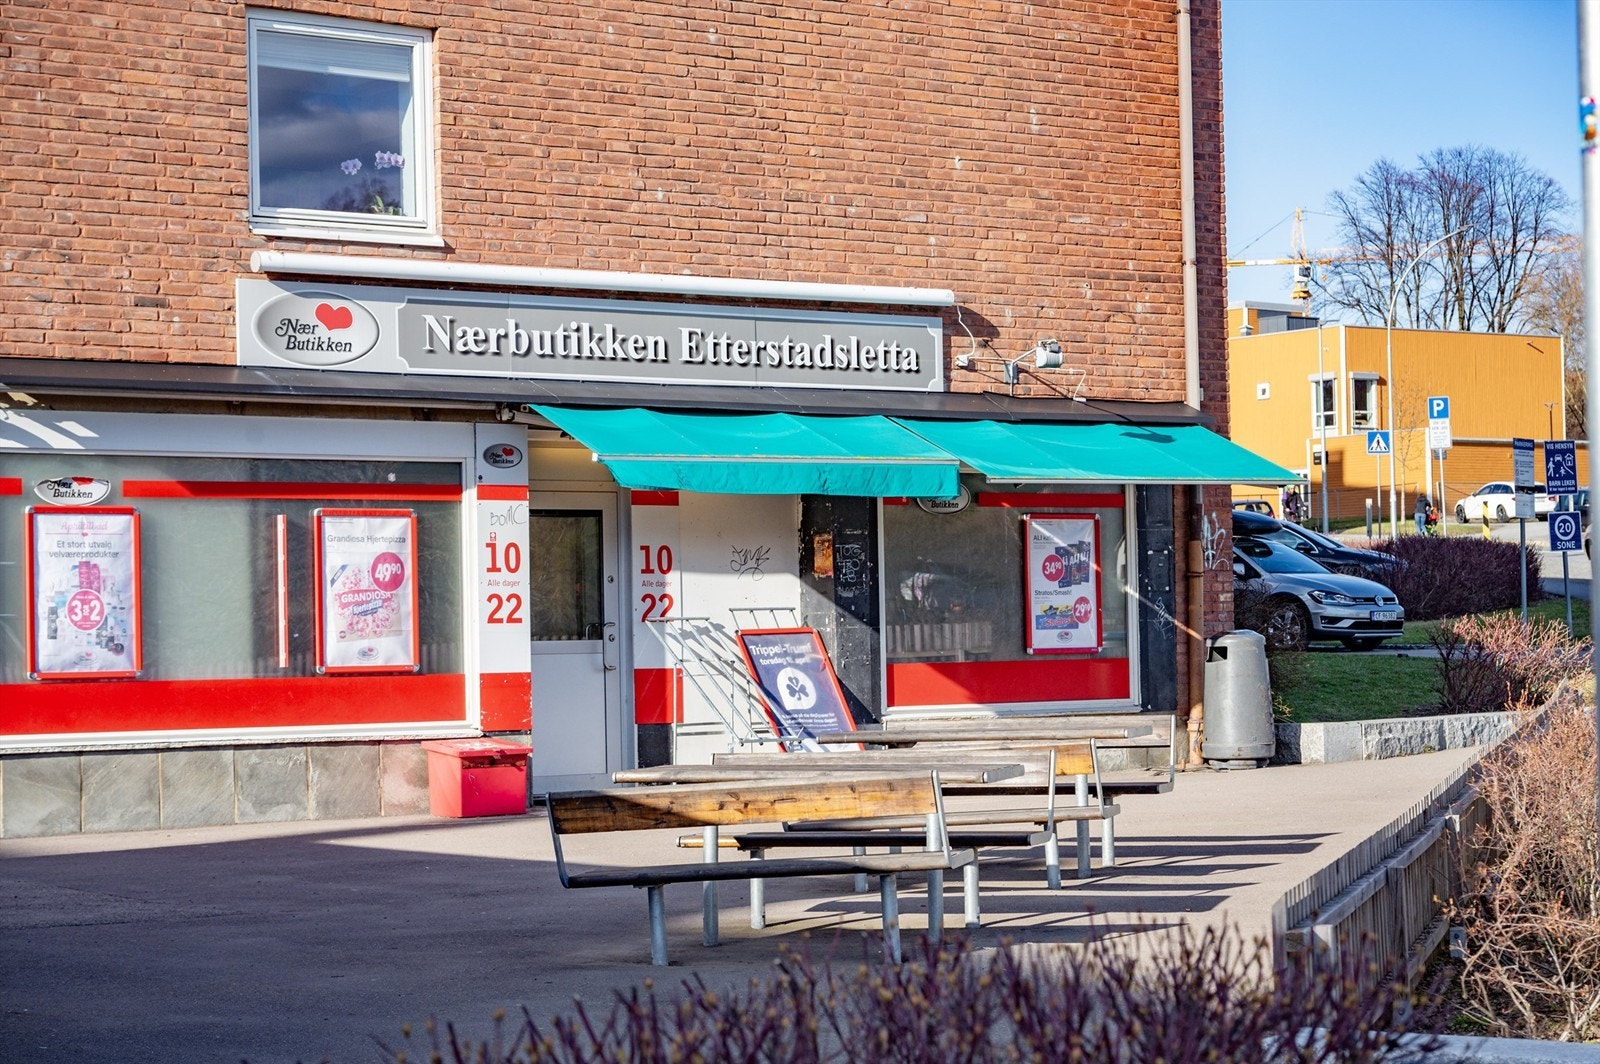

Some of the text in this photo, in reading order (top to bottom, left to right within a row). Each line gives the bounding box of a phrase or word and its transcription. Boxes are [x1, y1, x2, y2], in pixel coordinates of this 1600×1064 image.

[274, 317, 319, 337] Nær
[285, 335, 353, 352] Butikken
[421, 314, 920, 373] Nærbutikken Etterstadsletta
[1433, 399, 1445, 417] P
[53, 489, 93, 499] Butikken
[931, 500, 959, 508] Butikken
[1558, 522, 1572, 533] 20
[327, 534, 406, 545] Grandiosa Hjertepizza
[1557, 541, 1576, 549] SONE
[67, 541, 86, 549] stort
[88, 541, 113, 550] utvalg
[49, 550, 119, 560] velværeprodukter
[486, 542, 521, 573] 10
[640, 545, 673, 575] 10
[487, 579, 520, 588] Alle dager
[641, 580, 673, 589] Alle dager
[341, 591, 392, 603] GRANDIOSA
[486, 593, 523, 623] 22
[640, 593, 674, 623] 22
[750, 642, 812, 656] Trippel-Trumf
[760, 656, 787, 666] torsdag
